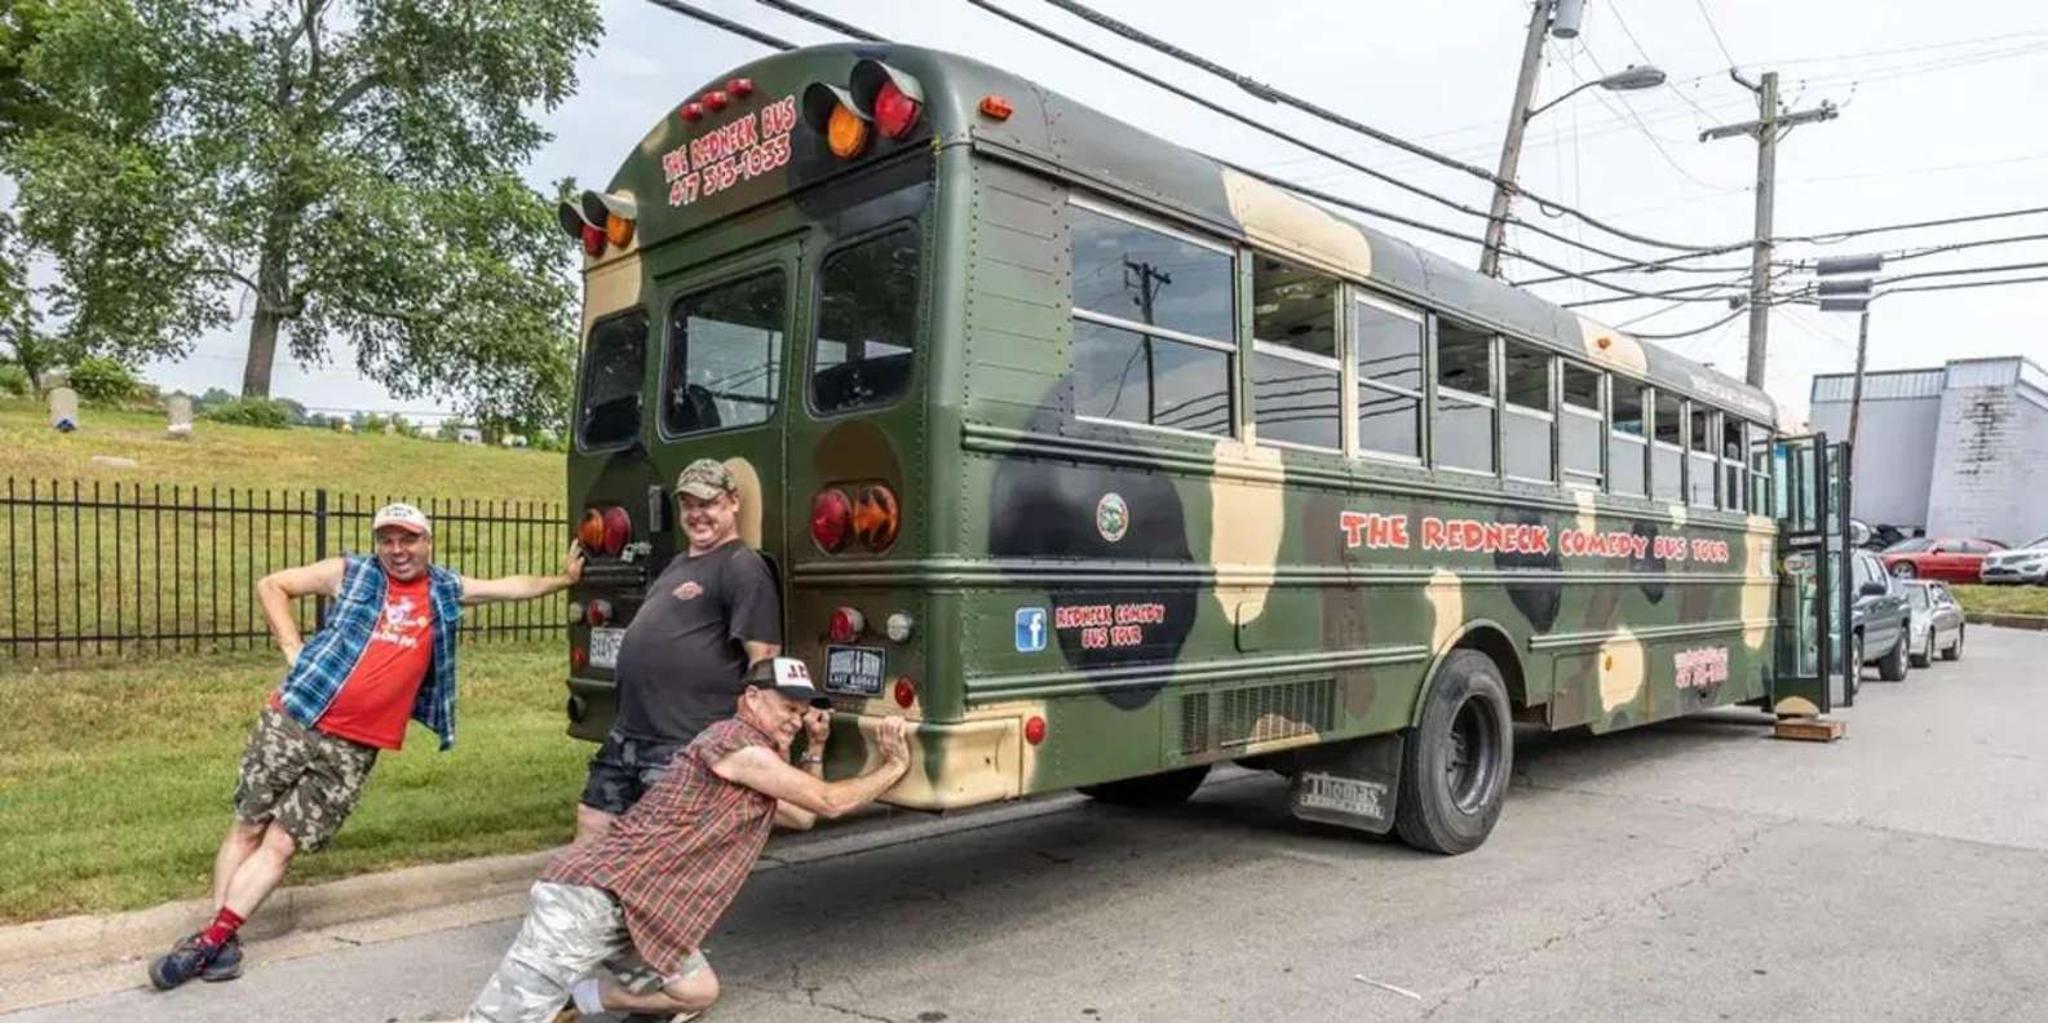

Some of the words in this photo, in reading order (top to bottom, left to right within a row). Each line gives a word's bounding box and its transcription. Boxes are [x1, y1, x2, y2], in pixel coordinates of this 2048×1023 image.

[662, 144, 689, 183] THE
[689, 112, 758, 172] REDNECK
[762, 94, 796, 139] BUS
[668, 172, 700, 207] 417
[702, 132, 792, 196] 313-1033
[1340, 511, 1409, 549] THE
[1422, 517, 1550, 556] REDNECK
[1559, 528, 1648, 560] COMEDY
[1653, 535, 1687, 562] BUS
[1692, 537, 1729, 564] TOUR
[1056, 605, 1113, 628] REDNECK
[1115, 604, 1165, 625] COMEDY
[1081, 627, 1108, 649] BUS
[1111, 625, 1141, 646] TOUR
[1302, 771, 1387, 804] Thomas
